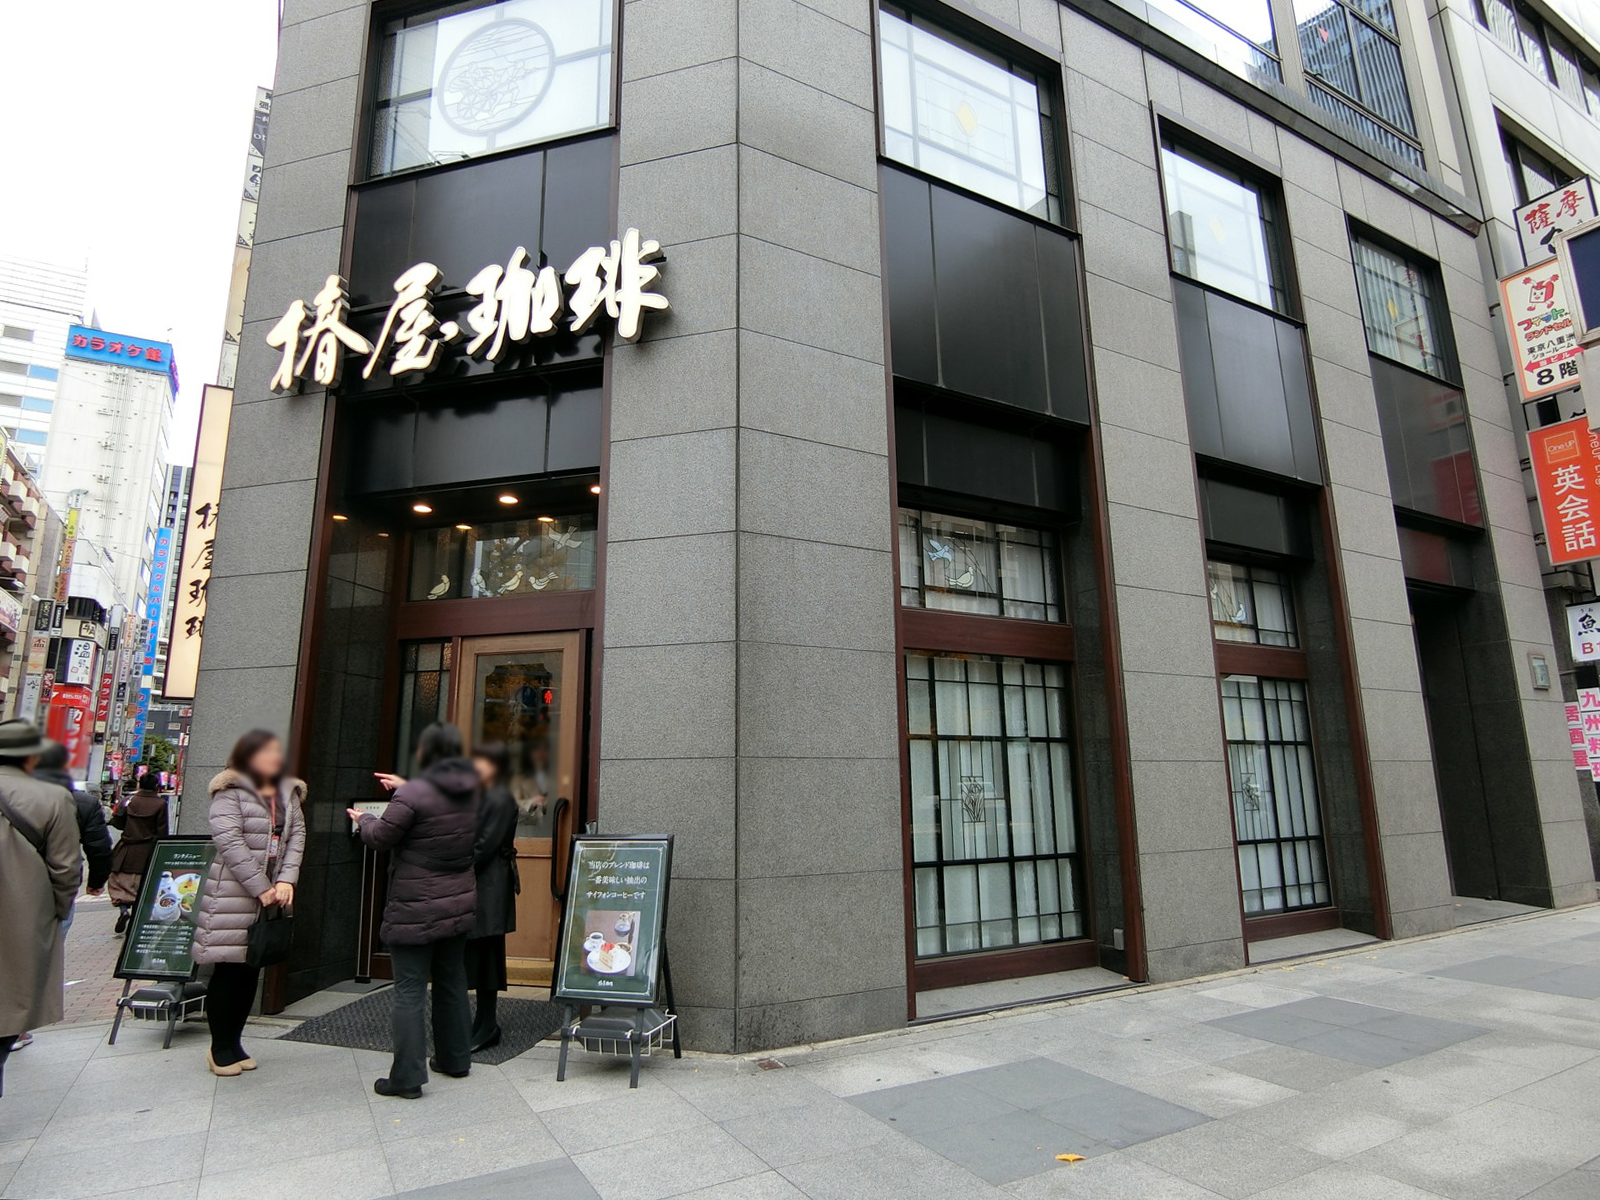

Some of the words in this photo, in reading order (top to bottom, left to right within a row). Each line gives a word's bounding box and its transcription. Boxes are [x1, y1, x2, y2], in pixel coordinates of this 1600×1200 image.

[1524, 189, 1585, 235] 薩摩
[72, 334, 164, 363] カラオケ館
[1532, 343, 1574, 360] ショールーム
[1551, 463, 1597, 552] 英会話
[99, 677, 112, 717] カラオケ
[588, 860, 650, 869] 当店のブレンド珈琲は
[587, 876, 648, 885] 一番美味しい抽出の
[586, 891, 646, 899] サイフォンコーヒーです
